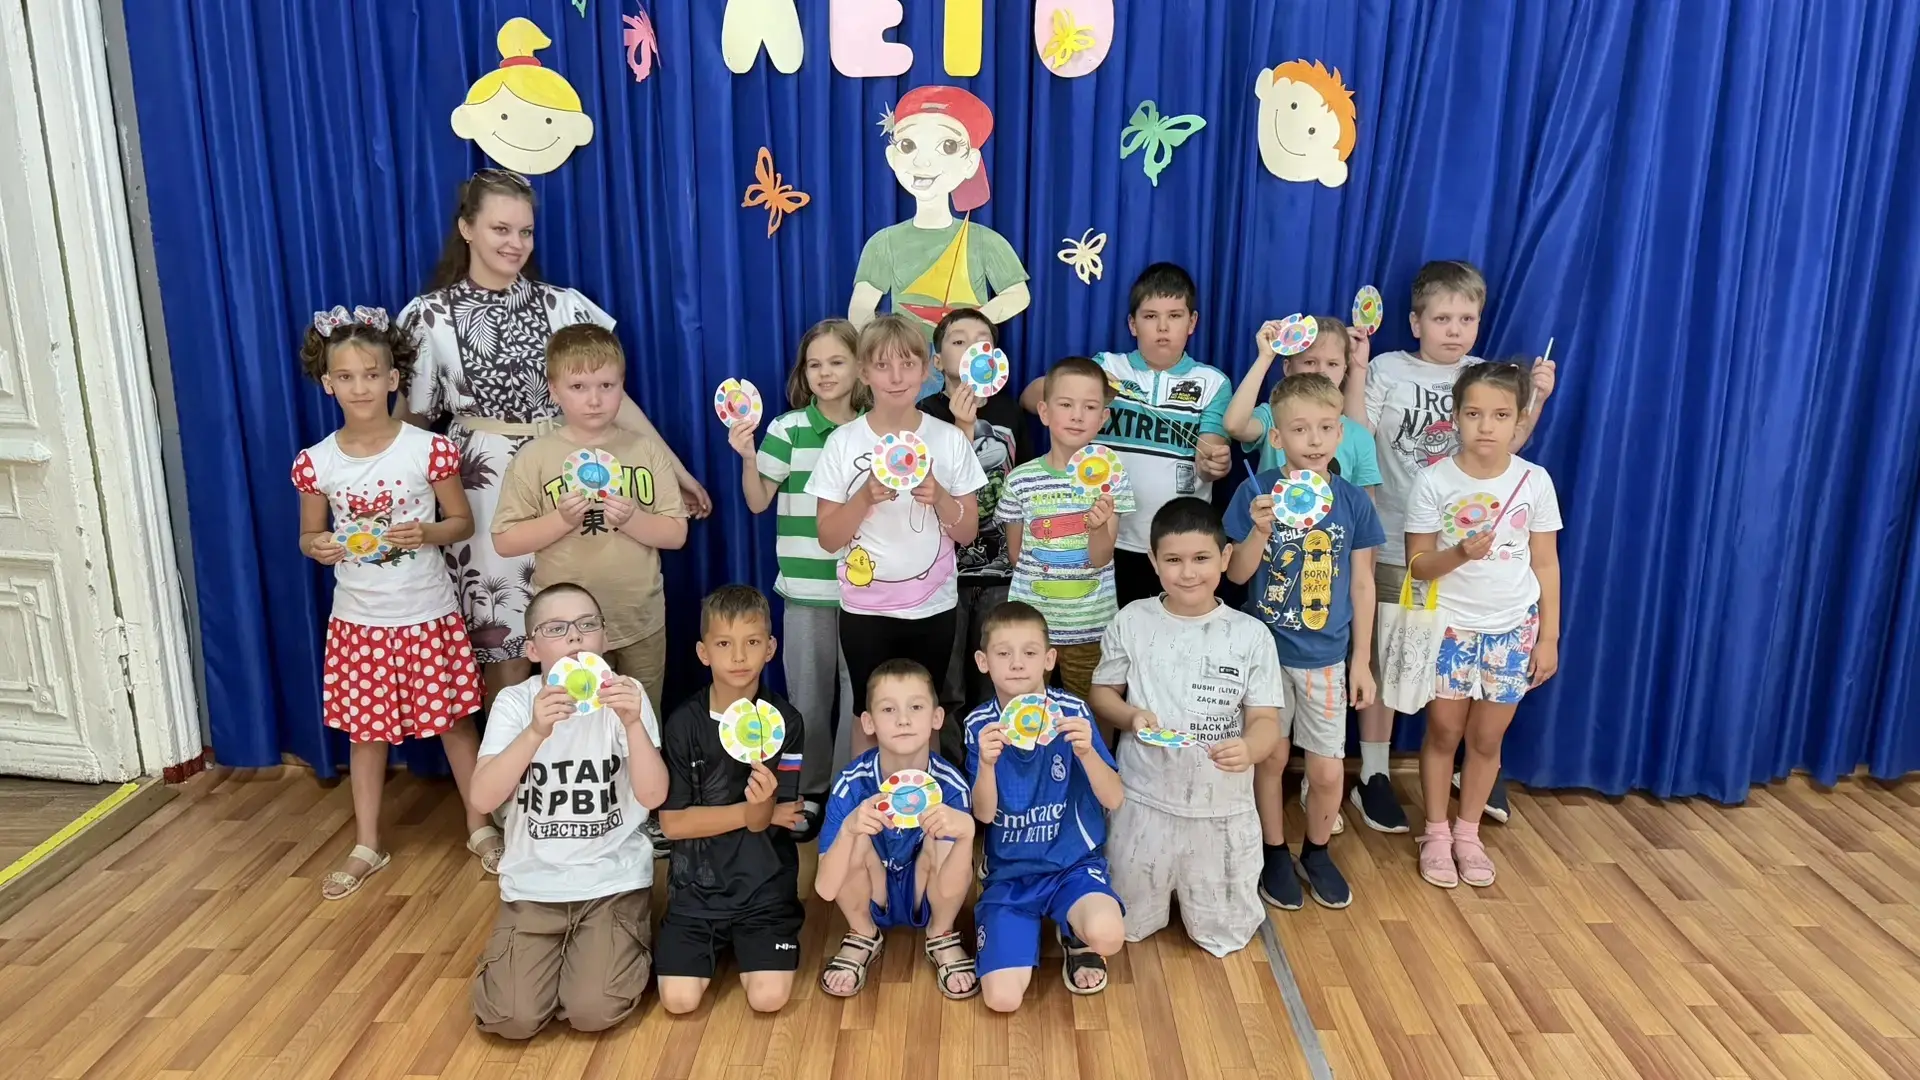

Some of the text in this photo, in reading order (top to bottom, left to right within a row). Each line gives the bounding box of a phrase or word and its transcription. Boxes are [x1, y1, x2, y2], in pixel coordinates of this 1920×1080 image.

[543, 465, 655, 510] TYO
[1271, 528, 1307, 543] TYLE
[1304, 570, 1330, 580] BORN
[1303, 583, 1327, 592] SKATE
[1192, 683, 1240, 695] BUSHI (LIVE)
[1197, 696, 1217, 705] ZACK
[1190, 722, 1221, 731] BLACK
[1193, 730, 1241, 741] IROUKIROU
[1001, 829, 1023, 843] FLY
